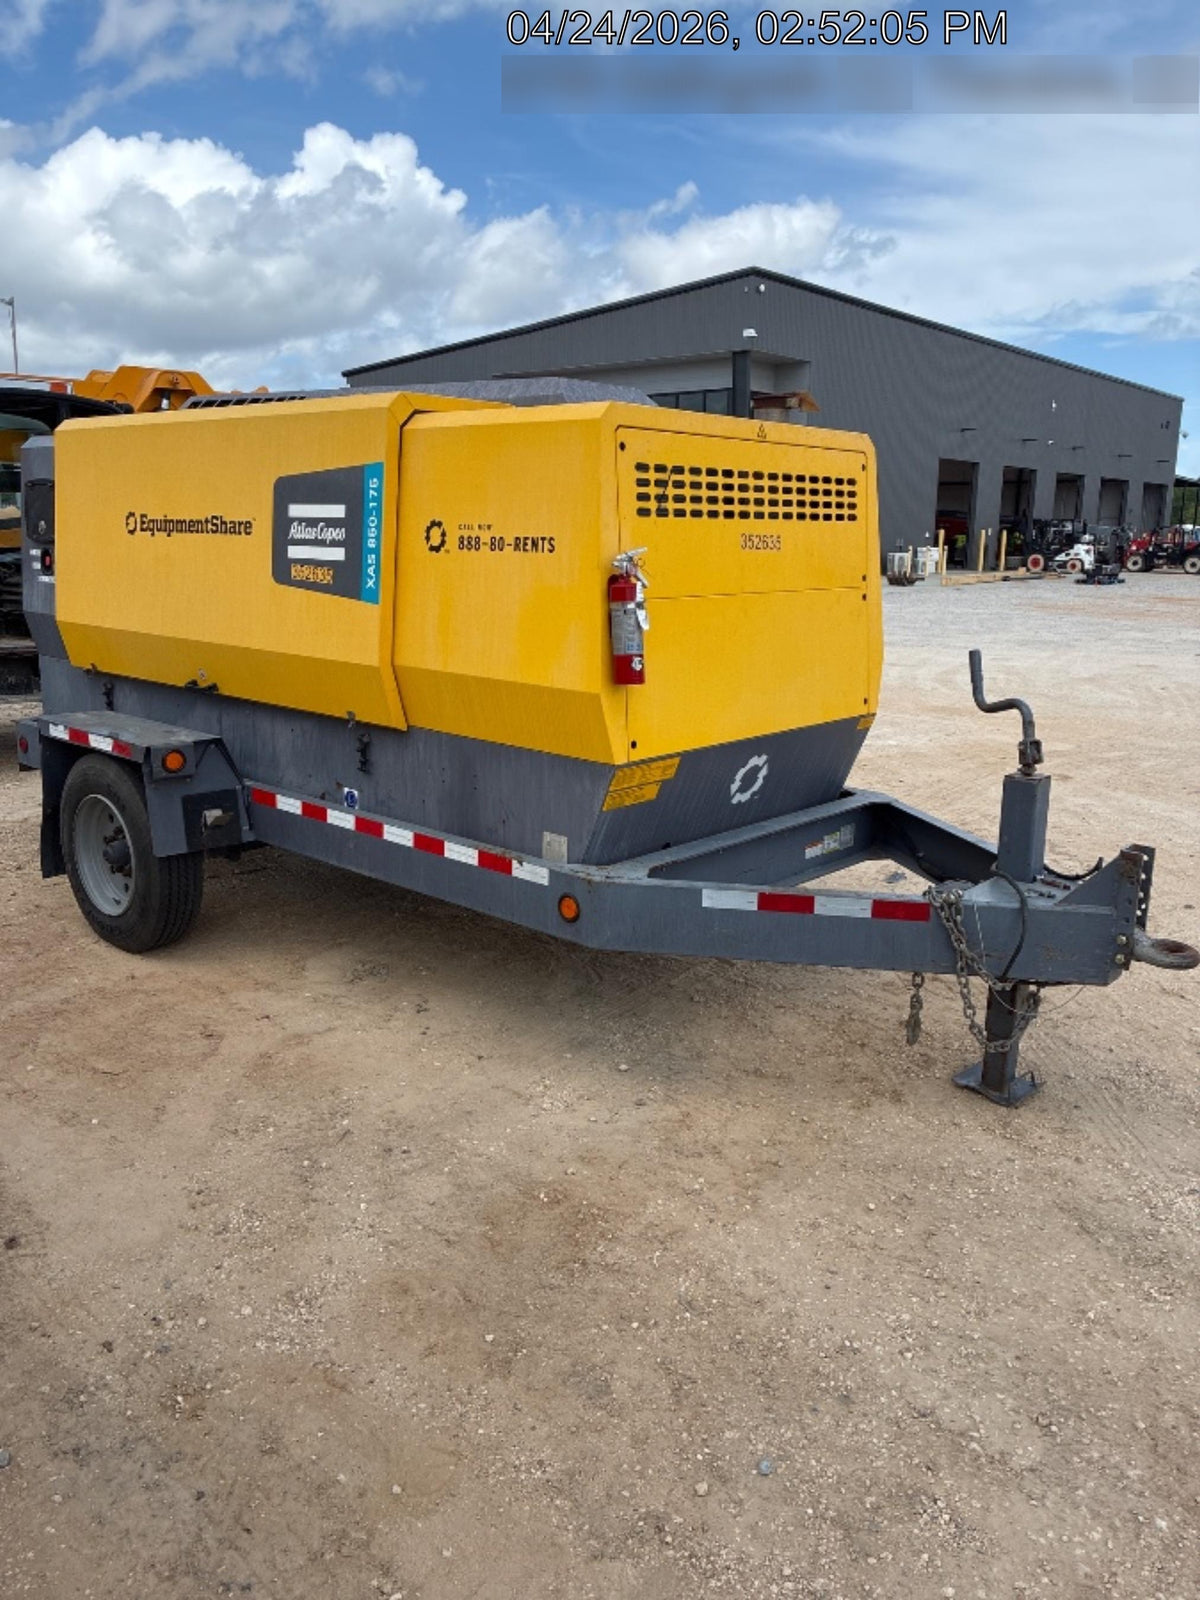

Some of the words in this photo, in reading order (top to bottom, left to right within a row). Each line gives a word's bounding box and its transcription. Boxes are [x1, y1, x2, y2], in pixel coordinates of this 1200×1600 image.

[139, 513, 253, 537] EquipmentShare
[288, 520, 317, 540] Atlas
[317, 522, 346, 545] Copco
[457, 534, 556, 554] 888-80-RENTS
[365, 554, 376, 589] XAS
